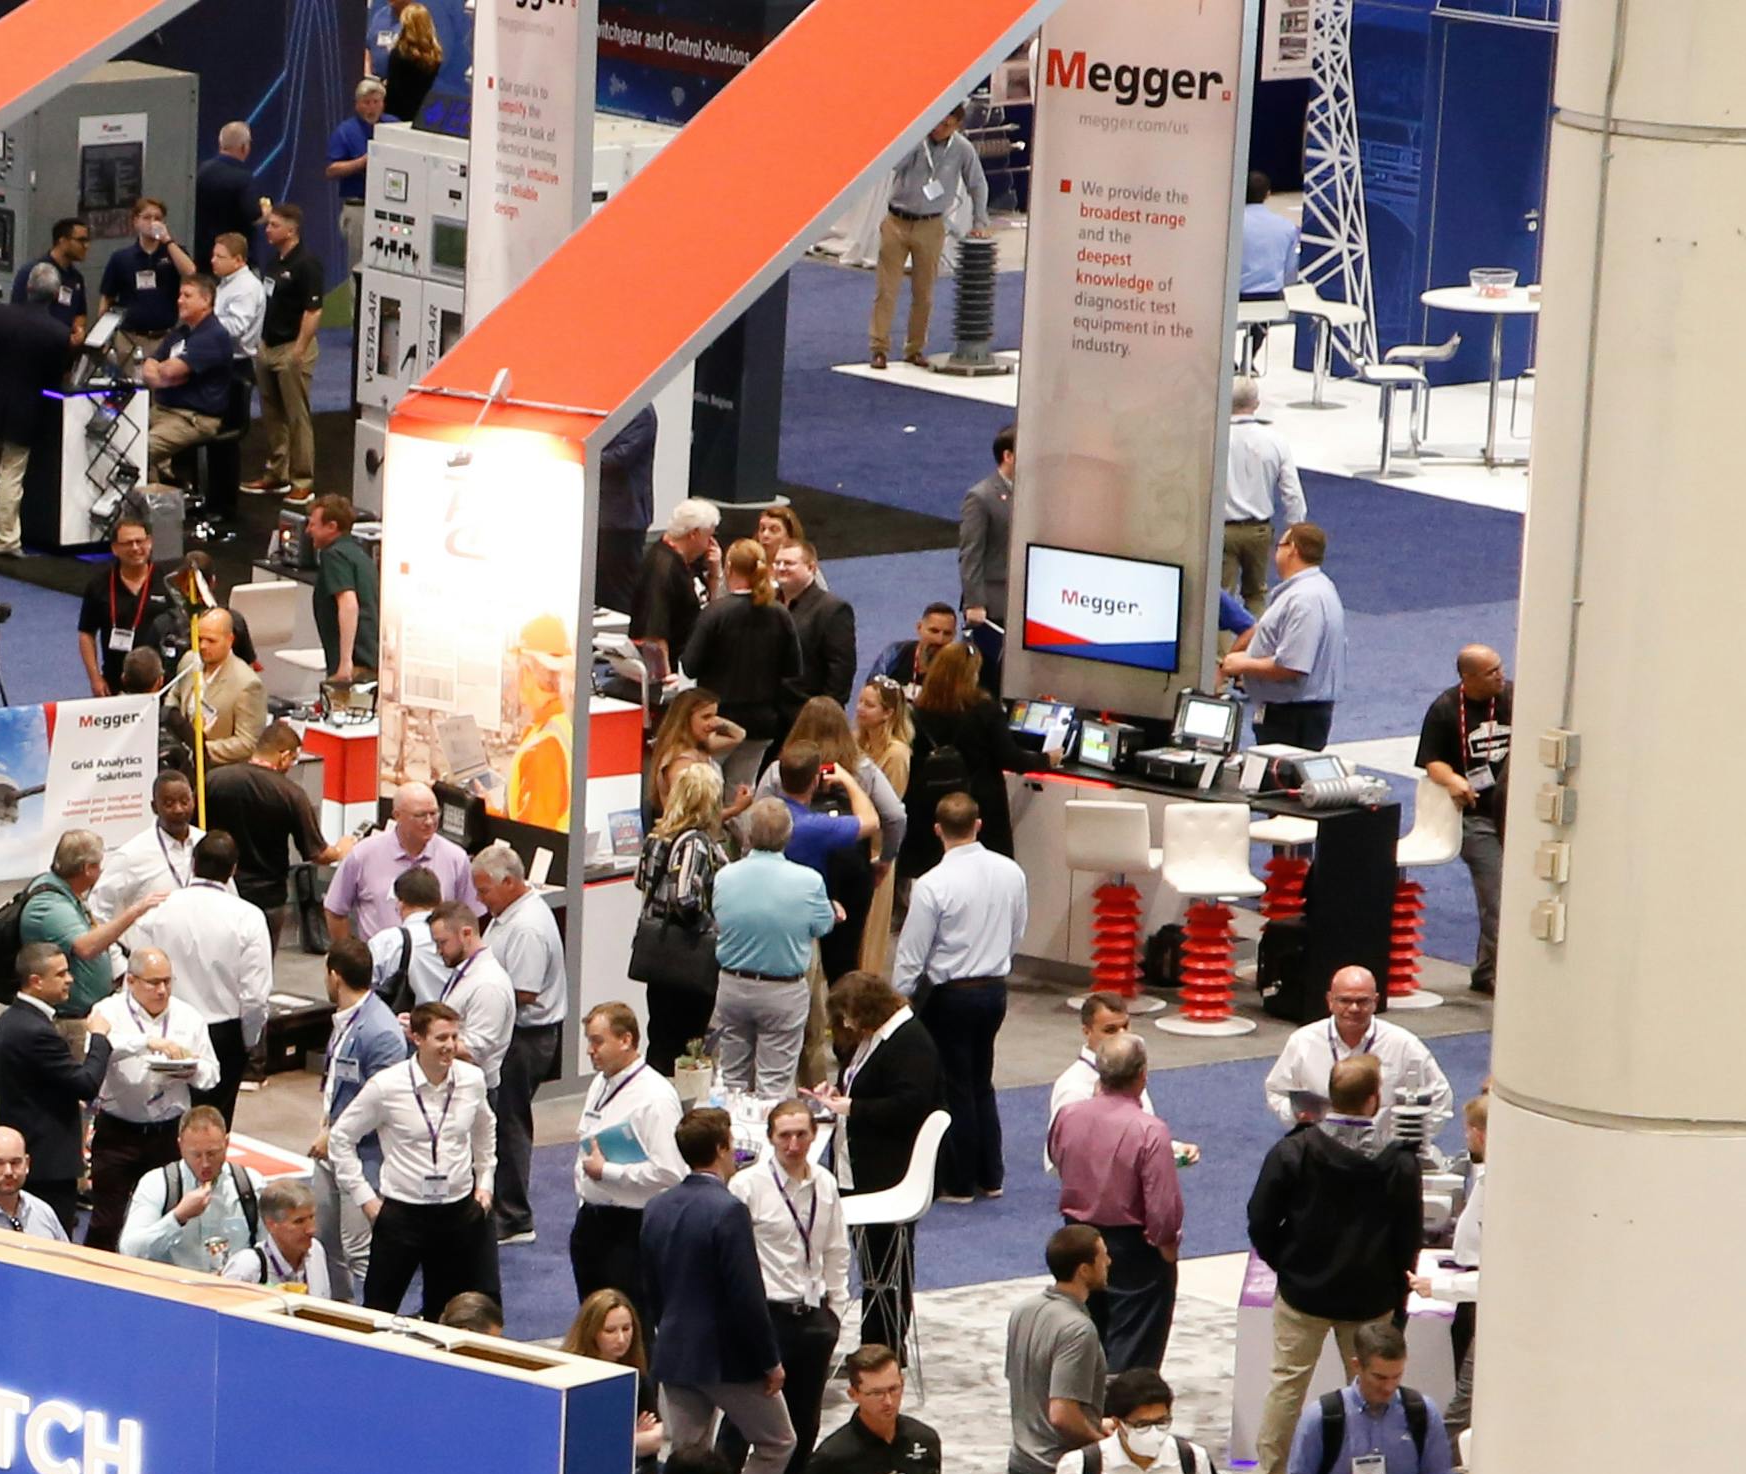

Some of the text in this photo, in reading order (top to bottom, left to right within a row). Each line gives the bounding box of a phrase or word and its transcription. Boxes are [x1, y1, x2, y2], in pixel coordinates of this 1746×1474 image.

[597, 21, 751, 66] witchgear and Control Solutions
[1045, 47, 1231, 109] Megger.
[1079, 113, 1188, 134] megger.com/us
[1081, 180, 1188, 204] We provide the
[1080, 203, 1186, 229] broadest range
[1078, 226, 1131, 244] and the
[1077, 247, 1132, 267] deepest
[1076, 268, 1173, 294] knowledge of
[1075, 292, 1176, 315] diagnostic test
[1073, 315, 1193, 338] equipment in the
[1072, 335, 1132, 358] industry.
[71, 756, 142, 770] Grid Analytics
[96, 771, 142, 782] Solutions
